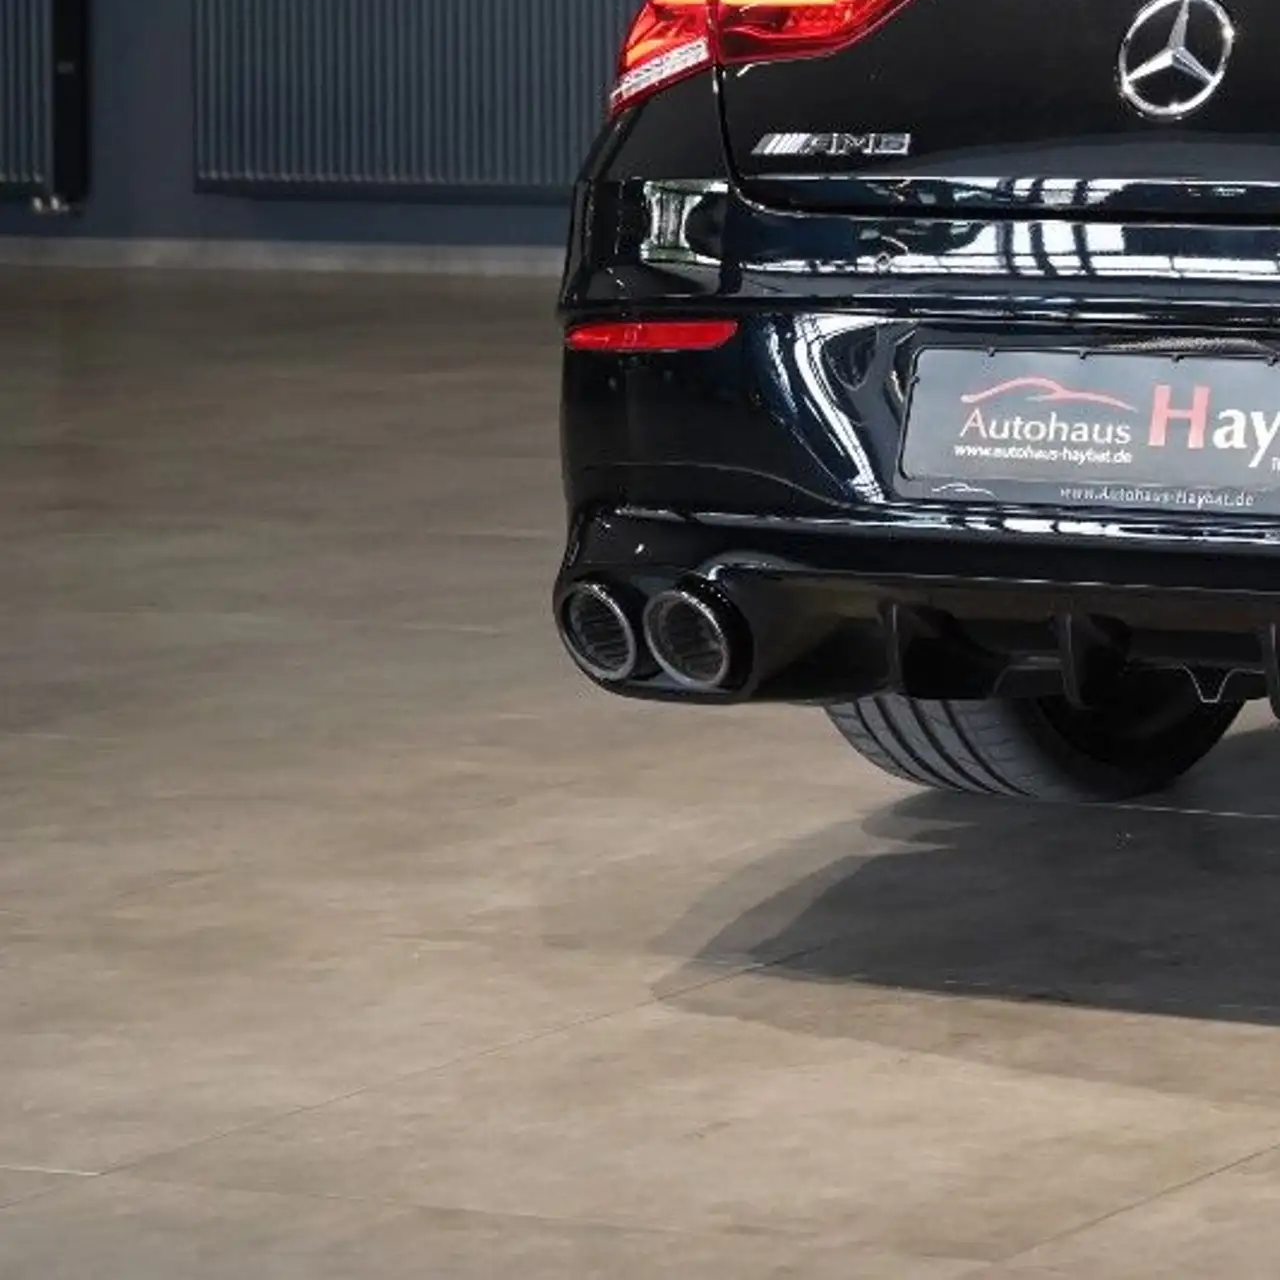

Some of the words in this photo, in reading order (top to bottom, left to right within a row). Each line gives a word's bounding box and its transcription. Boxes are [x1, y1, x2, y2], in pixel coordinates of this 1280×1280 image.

[798, 132, 911, 156] AMG
[959, 407, 1132, 445] Autohaus
[954, 444, 1133, 465] www.autohaus-haybat.de
